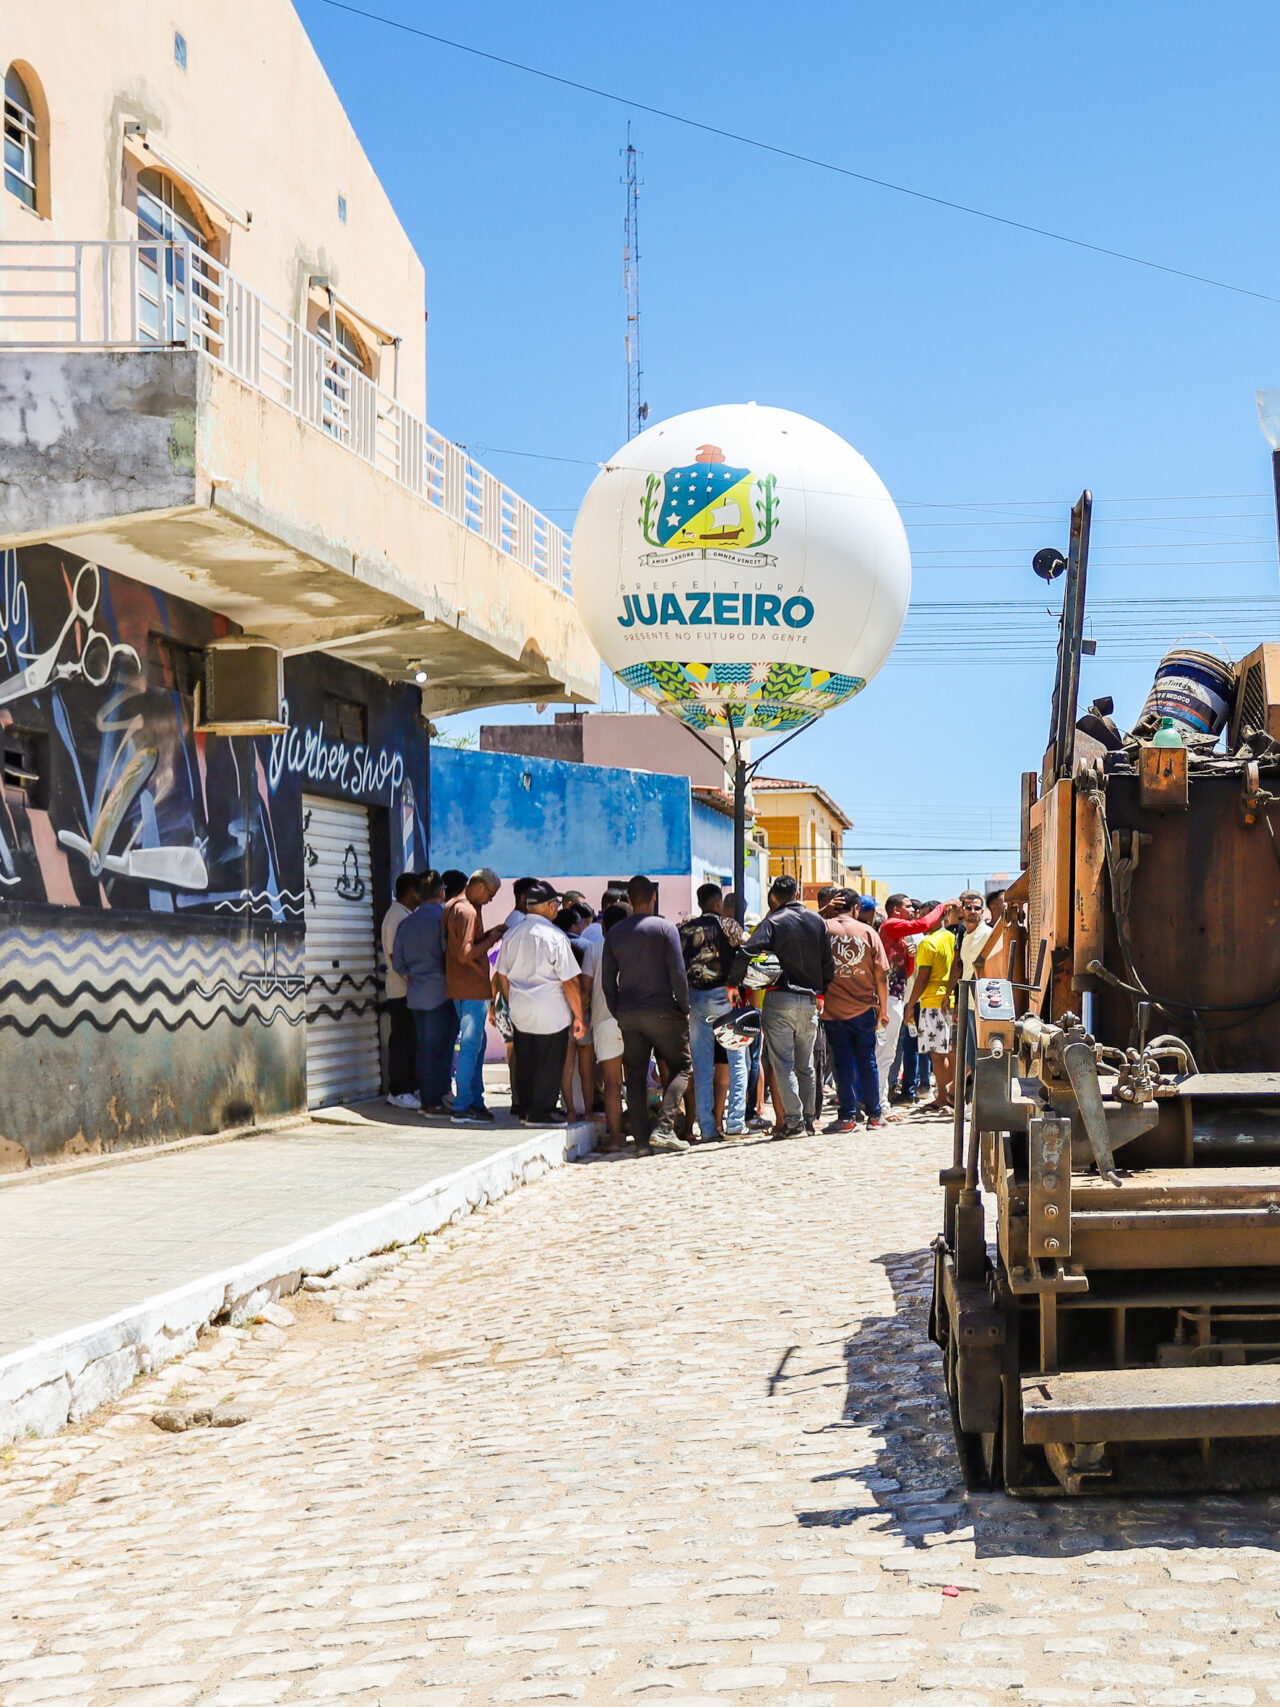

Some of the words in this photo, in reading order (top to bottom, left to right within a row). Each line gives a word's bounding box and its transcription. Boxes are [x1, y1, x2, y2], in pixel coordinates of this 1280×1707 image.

[713, 552, 736, 561] OMNIA
[620, 581, 805, 594] PREFEITURA
[617, 592, 815, 629] JUAZEIRO
[624, 632, 671, 641] PRESENTE
[675, 632, 692, 640] NO
[697, 632, 745, 641] FUTURO
[751, 632, 767, 641] DA
[772, 632, 809, 644] GENTE
